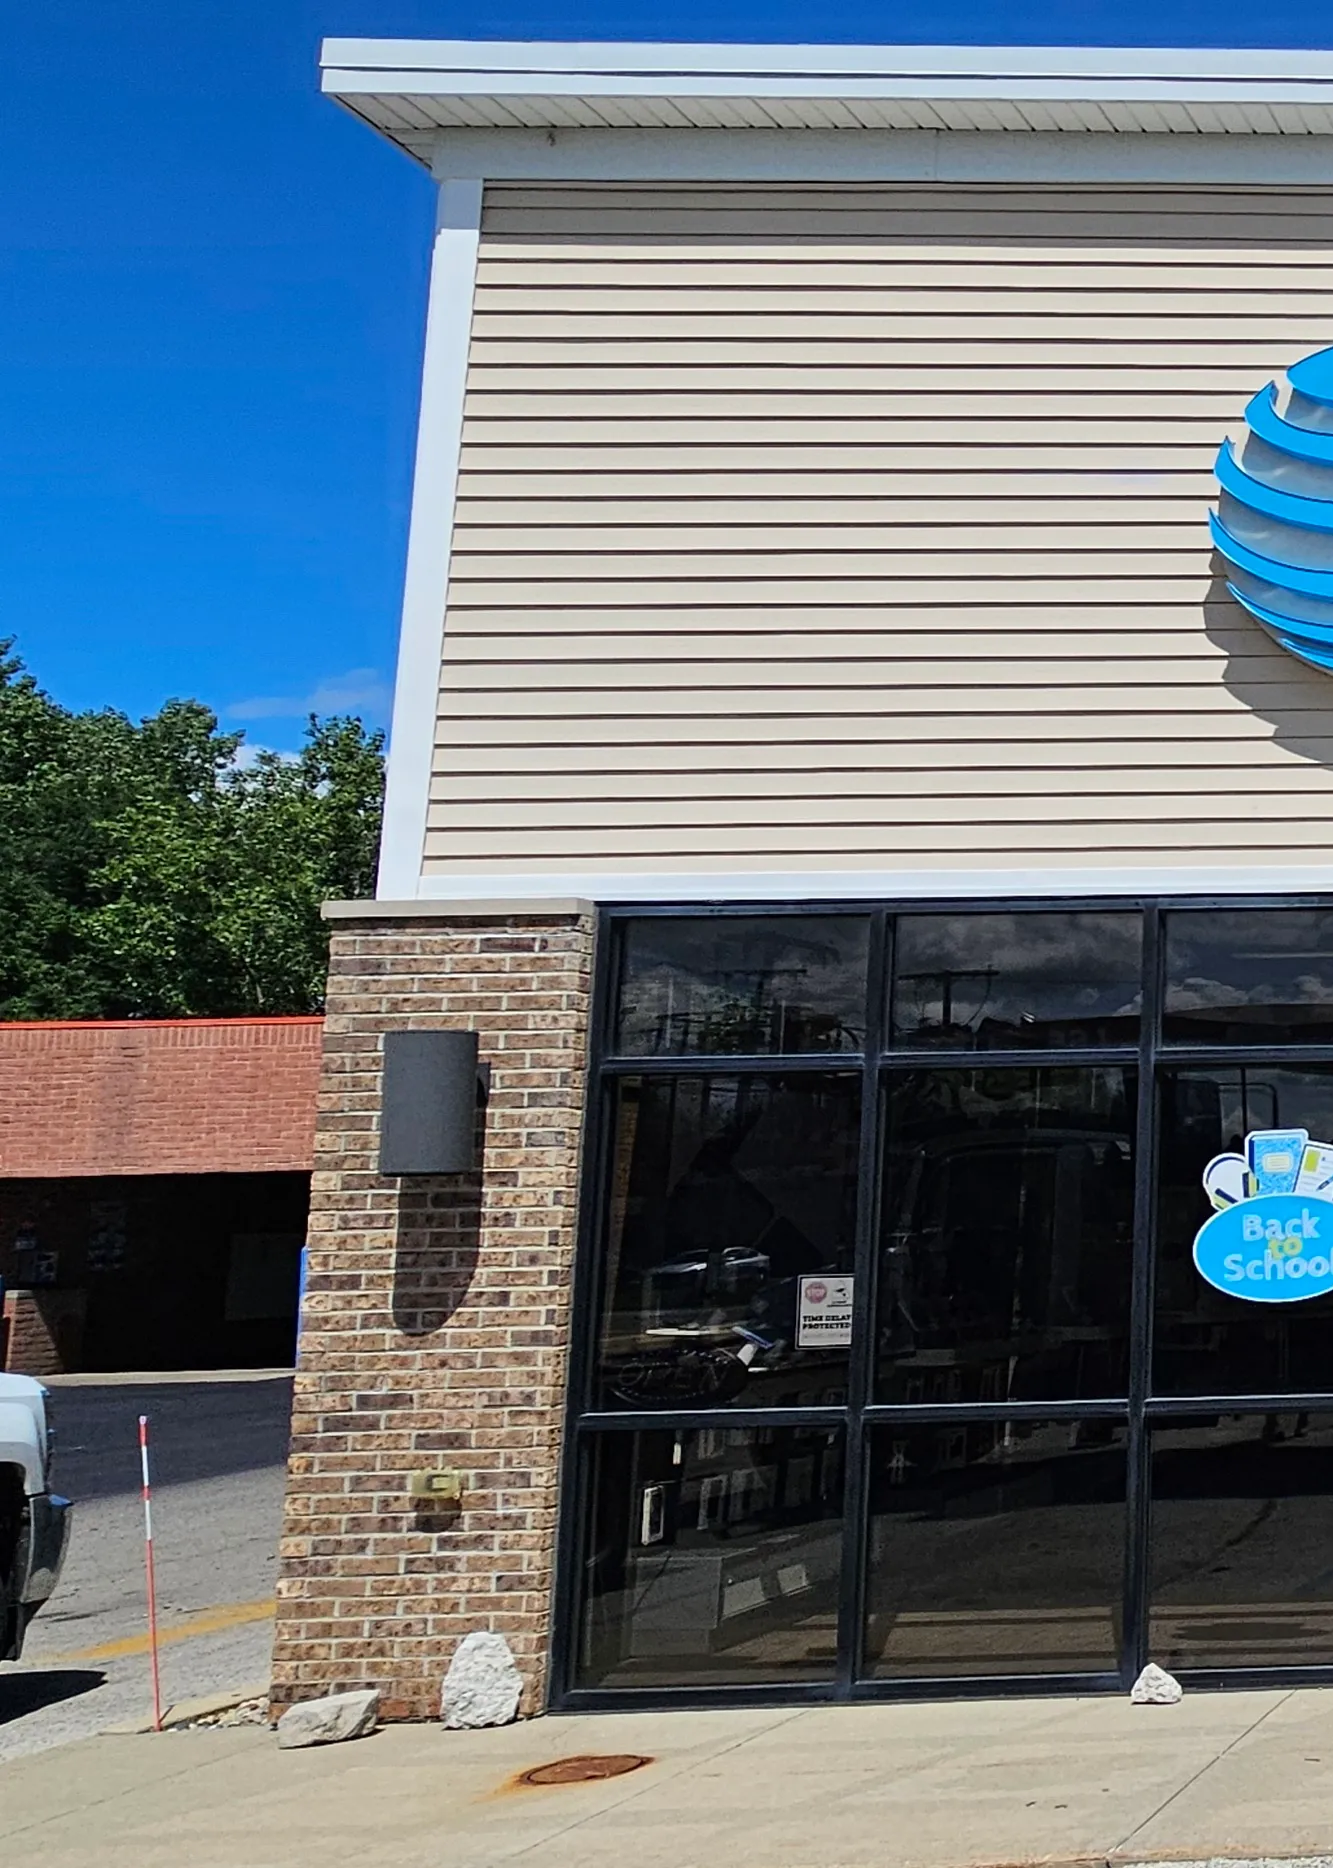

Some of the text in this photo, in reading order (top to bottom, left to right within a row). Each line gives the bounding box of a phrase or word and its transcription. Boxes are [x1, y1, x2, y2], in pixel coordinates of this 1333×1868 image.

[1242, 1207, 1321, 1242] Back
[1268, 1235, 1303, 1260] to
[802, 1322, 852, 1330] PROTECTED
